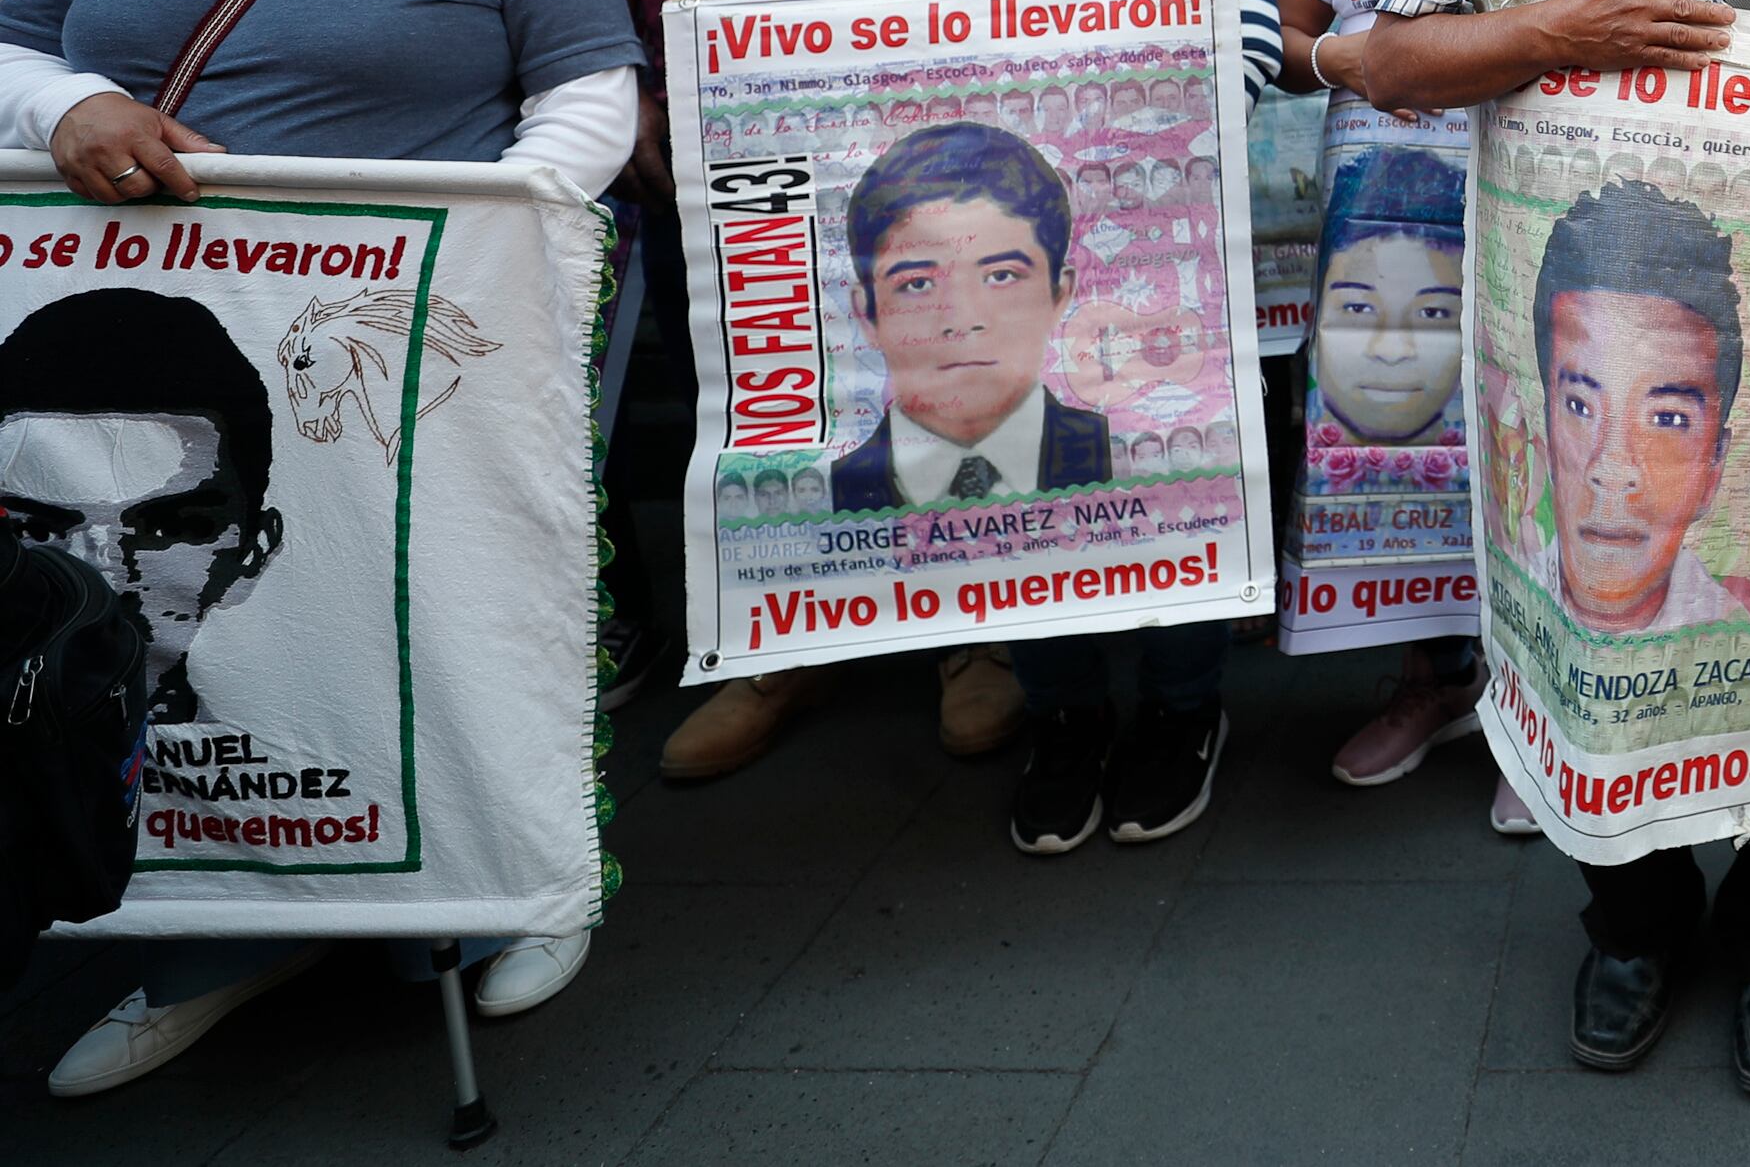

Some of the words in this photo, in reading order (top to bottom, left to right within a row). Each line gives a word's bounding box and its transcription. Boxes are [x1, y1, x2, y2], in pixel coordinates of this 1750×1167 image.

[707, 13, 833, 74] ¡Vivo
[851, 15, 909, 50] se
[928, 2, 971, 44] lo
[709, 85, 734, 100] Yo,
[745, 81, 776, 96] Jan
[779, 75, 834, 95] Nimmo,
[843, 70, 916, 90] Glasgow,
[925, 63, 994, 83] Escocia,
[1003, 56, 1060, 77] quiero
[1066, 52, 1109, 68] saber
[1118, 47, 1164, 65] dónde
[1171, 43, 1208, 61] está
[1617, 66, 1668, 103] lo
[1536, 121, 1600, 142] Glasgow,
[1612, 128, 1690, 151] Escocia,
[710, 155, 812, 215] 43!
[23, 233, 80, 269] se
[95, 221, 150, 270] lo
[162, 223, 407, 280] llevaron!
[724, 215, 818, 358] FALTAN
[732, 359, 823, 448] NOS
[737, 564, 776, 581] Hijo
[783, 564, 803, 577] de
[811, 556, 886, 576] Epifanio
[893, 555, 903, 570] y
[911, 547, 968, 564] Blanca
[996, 543, 1013, 556] 19
[1020, 536, 1060, 552] años
[1085, 527, 1124, 544] Juan
[1157, 515, 1230, 535] Escudero
[819, 525, 908, 555] JORGE
[928, 507, 1056, 544] ÁLVAREZ
[1074, 497, 1149, 526] NAVA
[1357, 539, 1375, 551] 19
[1383, 537, 1417, 549] Años
[1391, 509, 1453, 530] CRUZ
[721, 545, 744, 561] DE
[748, 590, 878, 651] ¡Vivo
[894, 581, 946, 623] lo
[958, 542, 1220, 624] queremos!
[1298, 576, 1337, 615] lo
[1568, 662, 1678, 702] MENDOZA
[1611, 710, 1629, 724] 32
[1635, 703, 1668, 720] años
[1690, 690, 1742, 711] APANGO,
[1538, 717, 1555, 778] lo
[146, 804, 380, 849] queremos!
